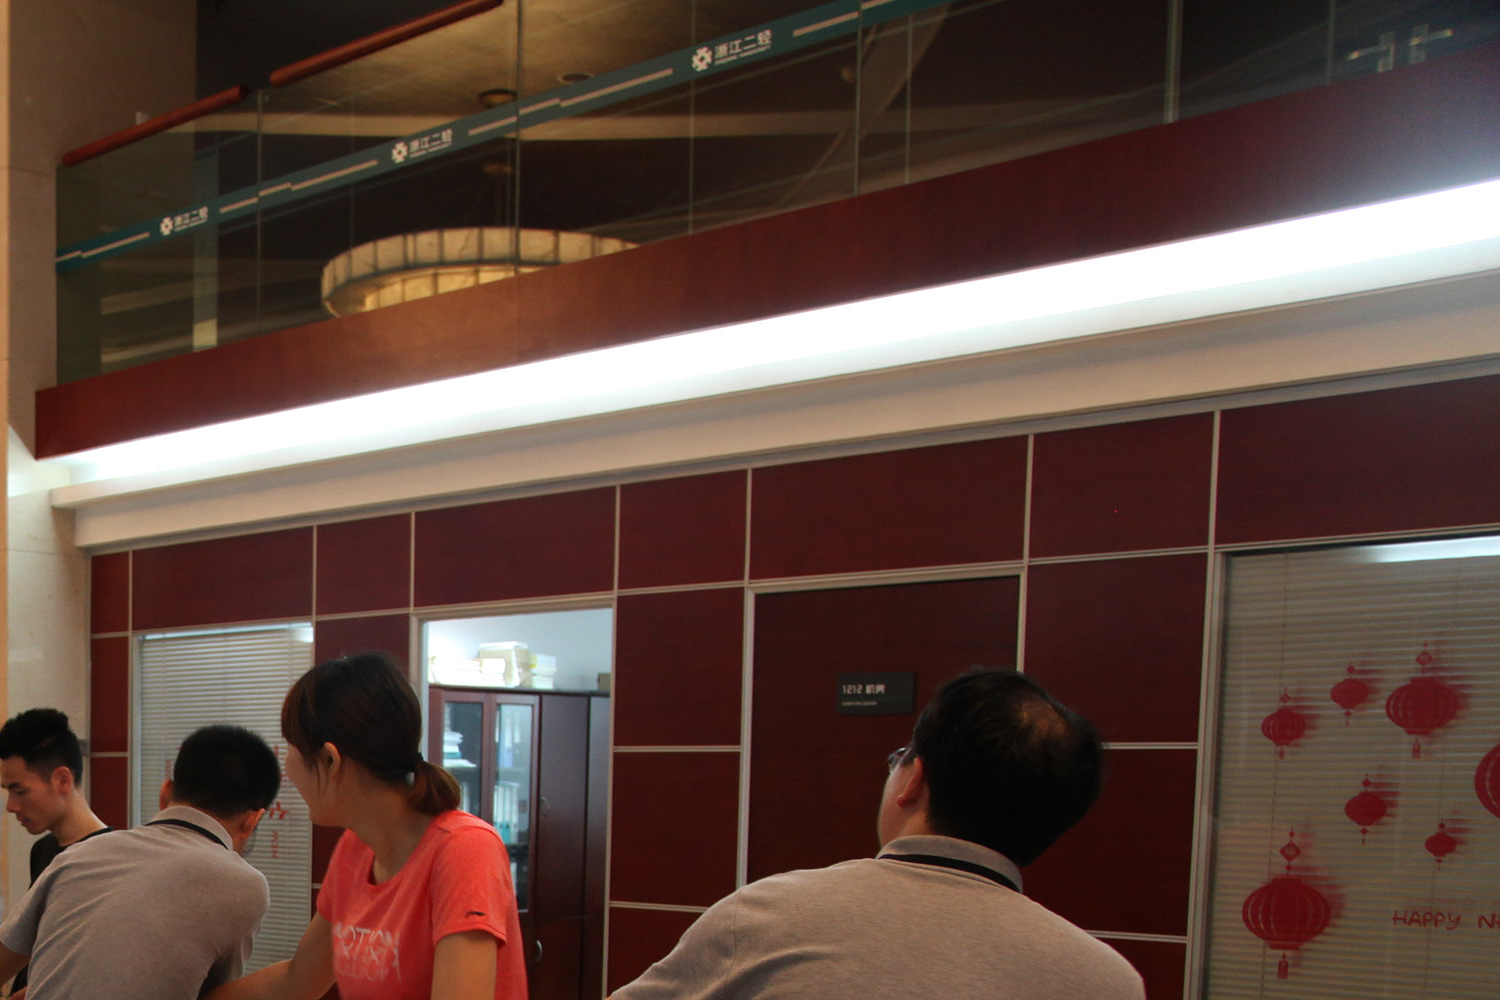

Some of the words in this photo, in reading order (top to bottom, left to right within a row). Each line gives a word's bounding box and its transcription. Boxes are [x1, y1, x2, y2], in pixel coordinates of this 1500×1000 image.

[714, 28, 772, 58] 浙江二轻
[842, 684, 863, 694] 1212
[1392, 910, 1461, 930] HAPPY
